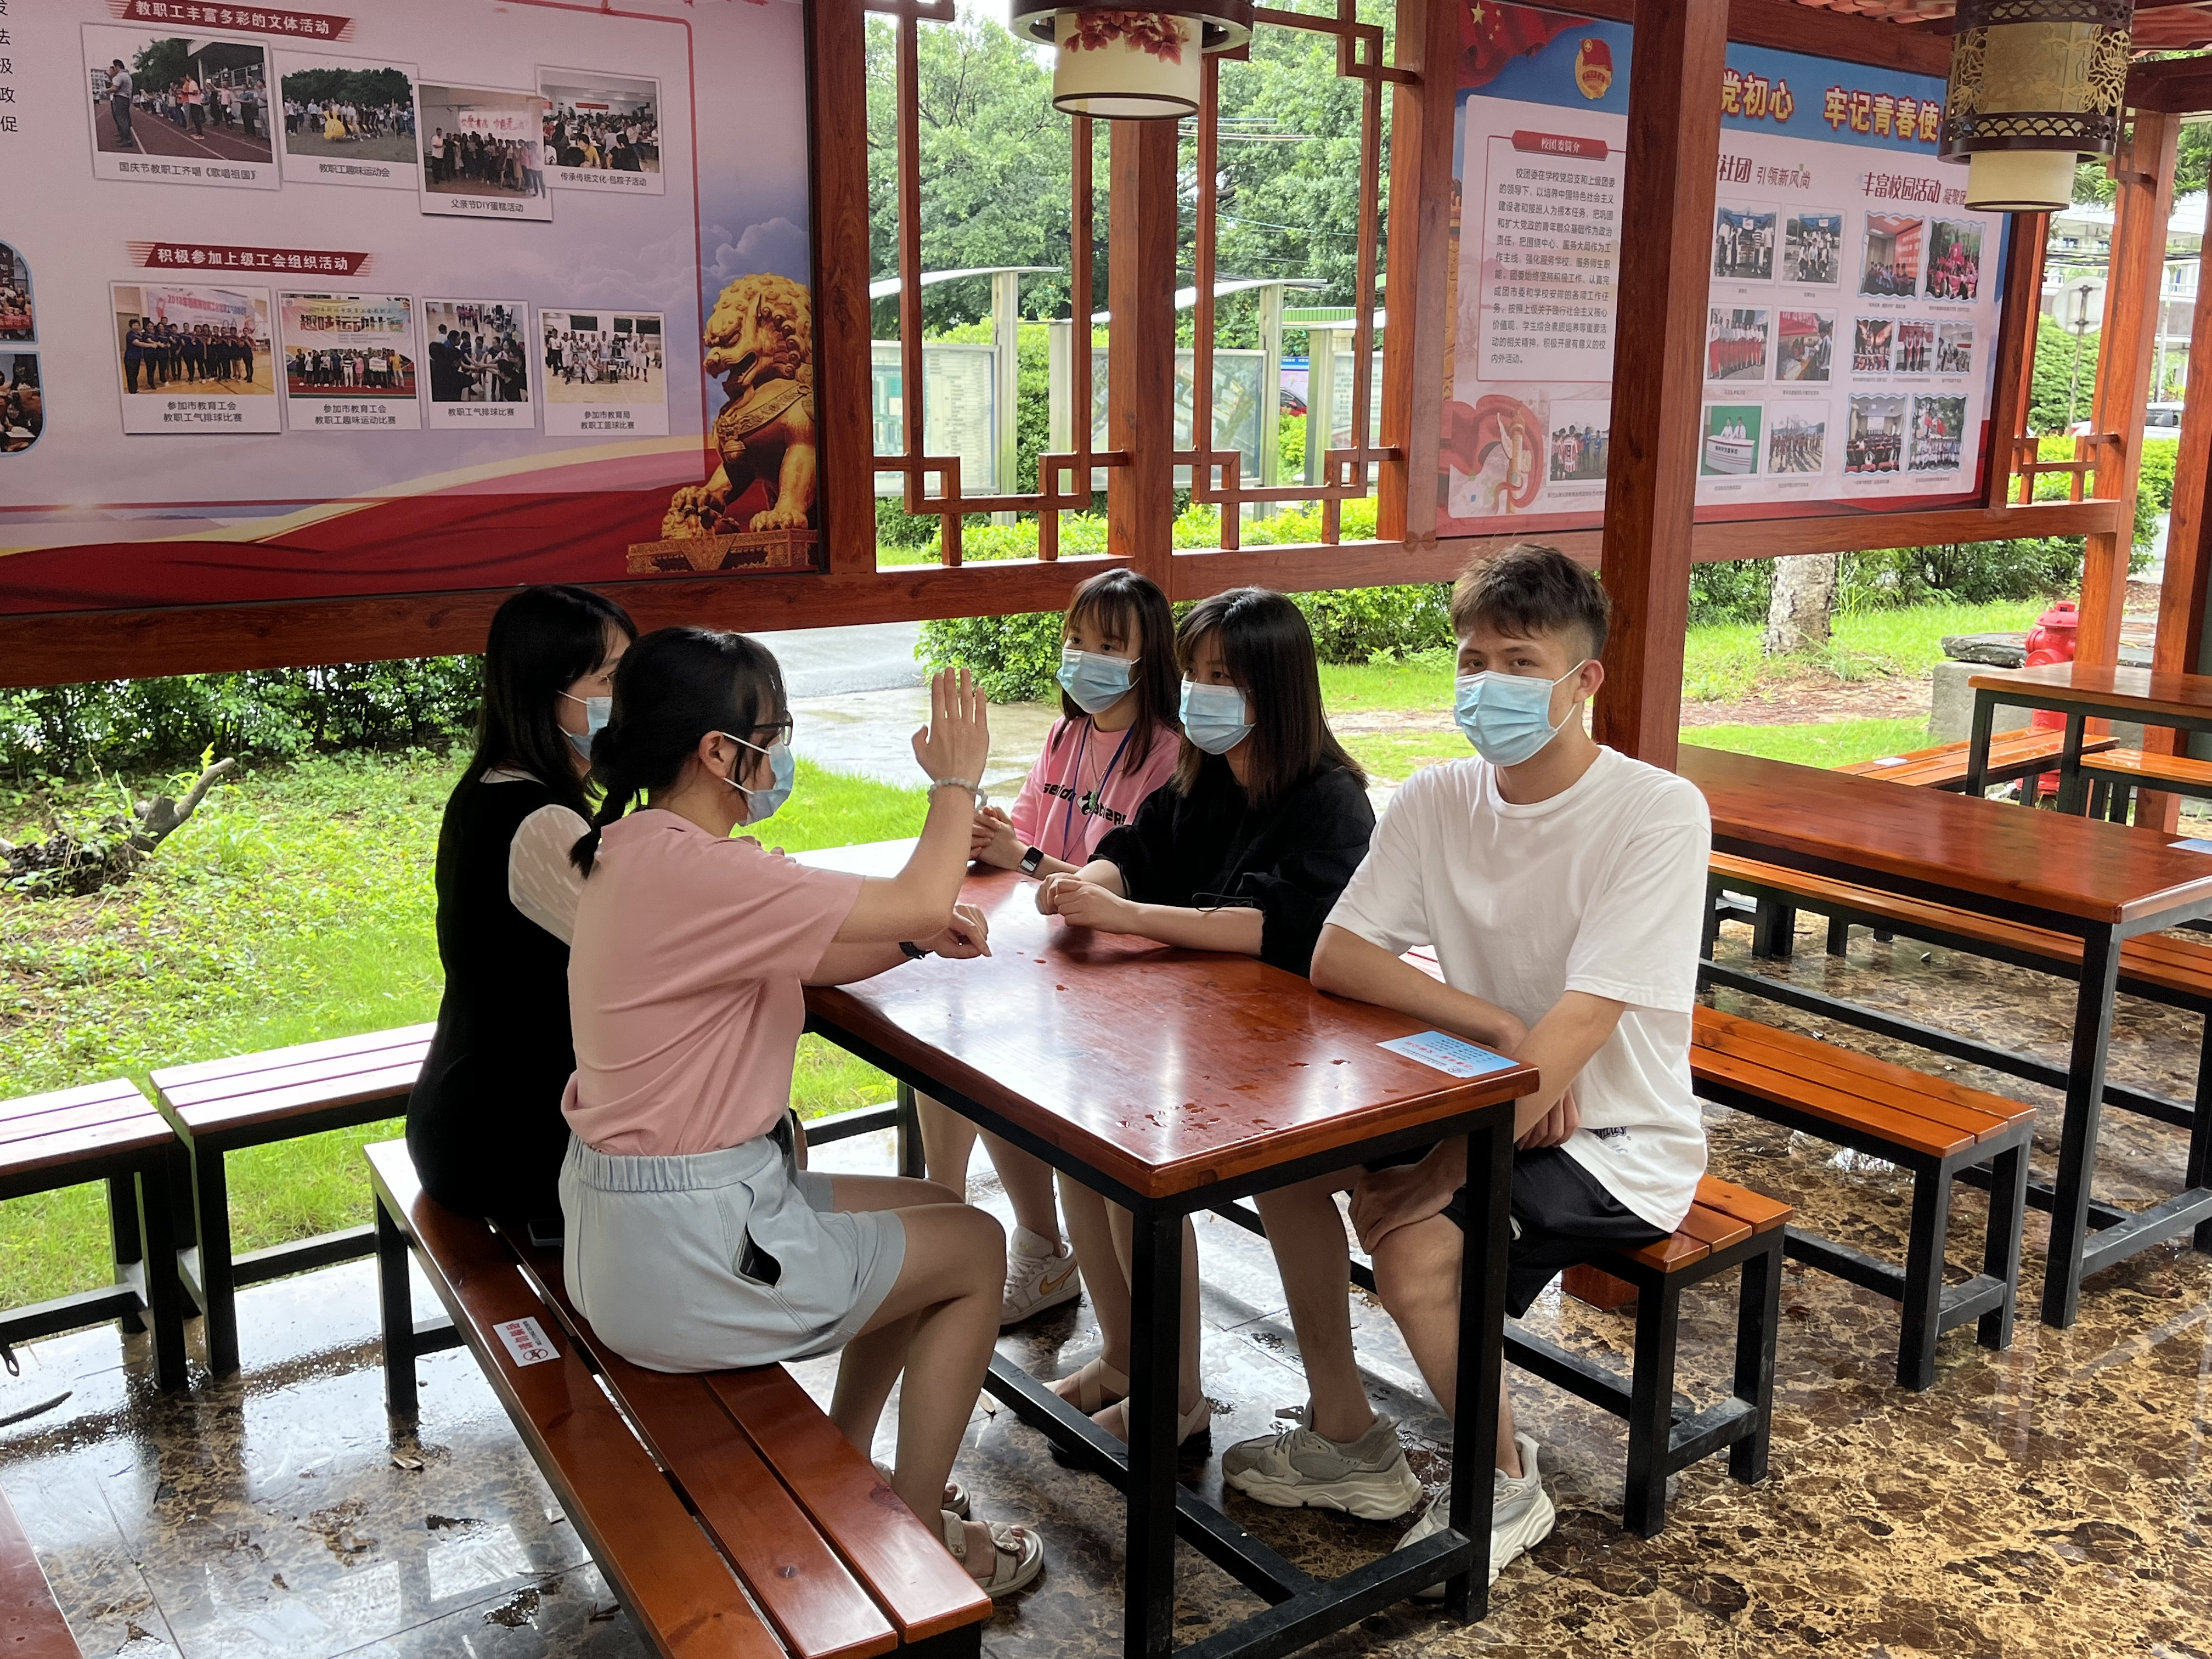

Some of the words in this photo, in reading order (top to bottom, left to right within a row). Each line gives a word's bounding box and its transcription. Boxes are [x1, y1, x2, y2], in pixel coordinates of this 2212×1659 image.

[136, 0, 330, 35] 教职工丰富多彩的文体活动
[1722, 67, 1794, 122] 党初心
[1824, 85, 1943, 142] 牢记青春使
[1, 115, 19, 132] 促
[1541, 137, 1581, 154] 校团委简介
[119, 162, 256, 180] 国庆节教职工齐唱《歌唱祖国》
[319, 163, 390, 177] 教职工趣味运动会
[1718, 154, 1752, 183] 社团
[1757, 166, 1811, 189] 引领新风尚
[1861, 171, 1941, 204] 丰富校园活动
[451, 199, 523, 212] 父亲节DIY蛋糕活动
[157, 248, 348, 271] 积极参加上级工会组织活动
[167, 401, 236, 410] 参加市教育工会
[323, 404, 386, 414] 参加市教育工会
[448, 408, 515, 416] 教职工气排球比赛
[163, 413, 242, 422] 教职工气排球比赛
[315, 415, 396, 425] 教职工趣味运动比赛
[584, 410, 630, 419] 参加市教育局
